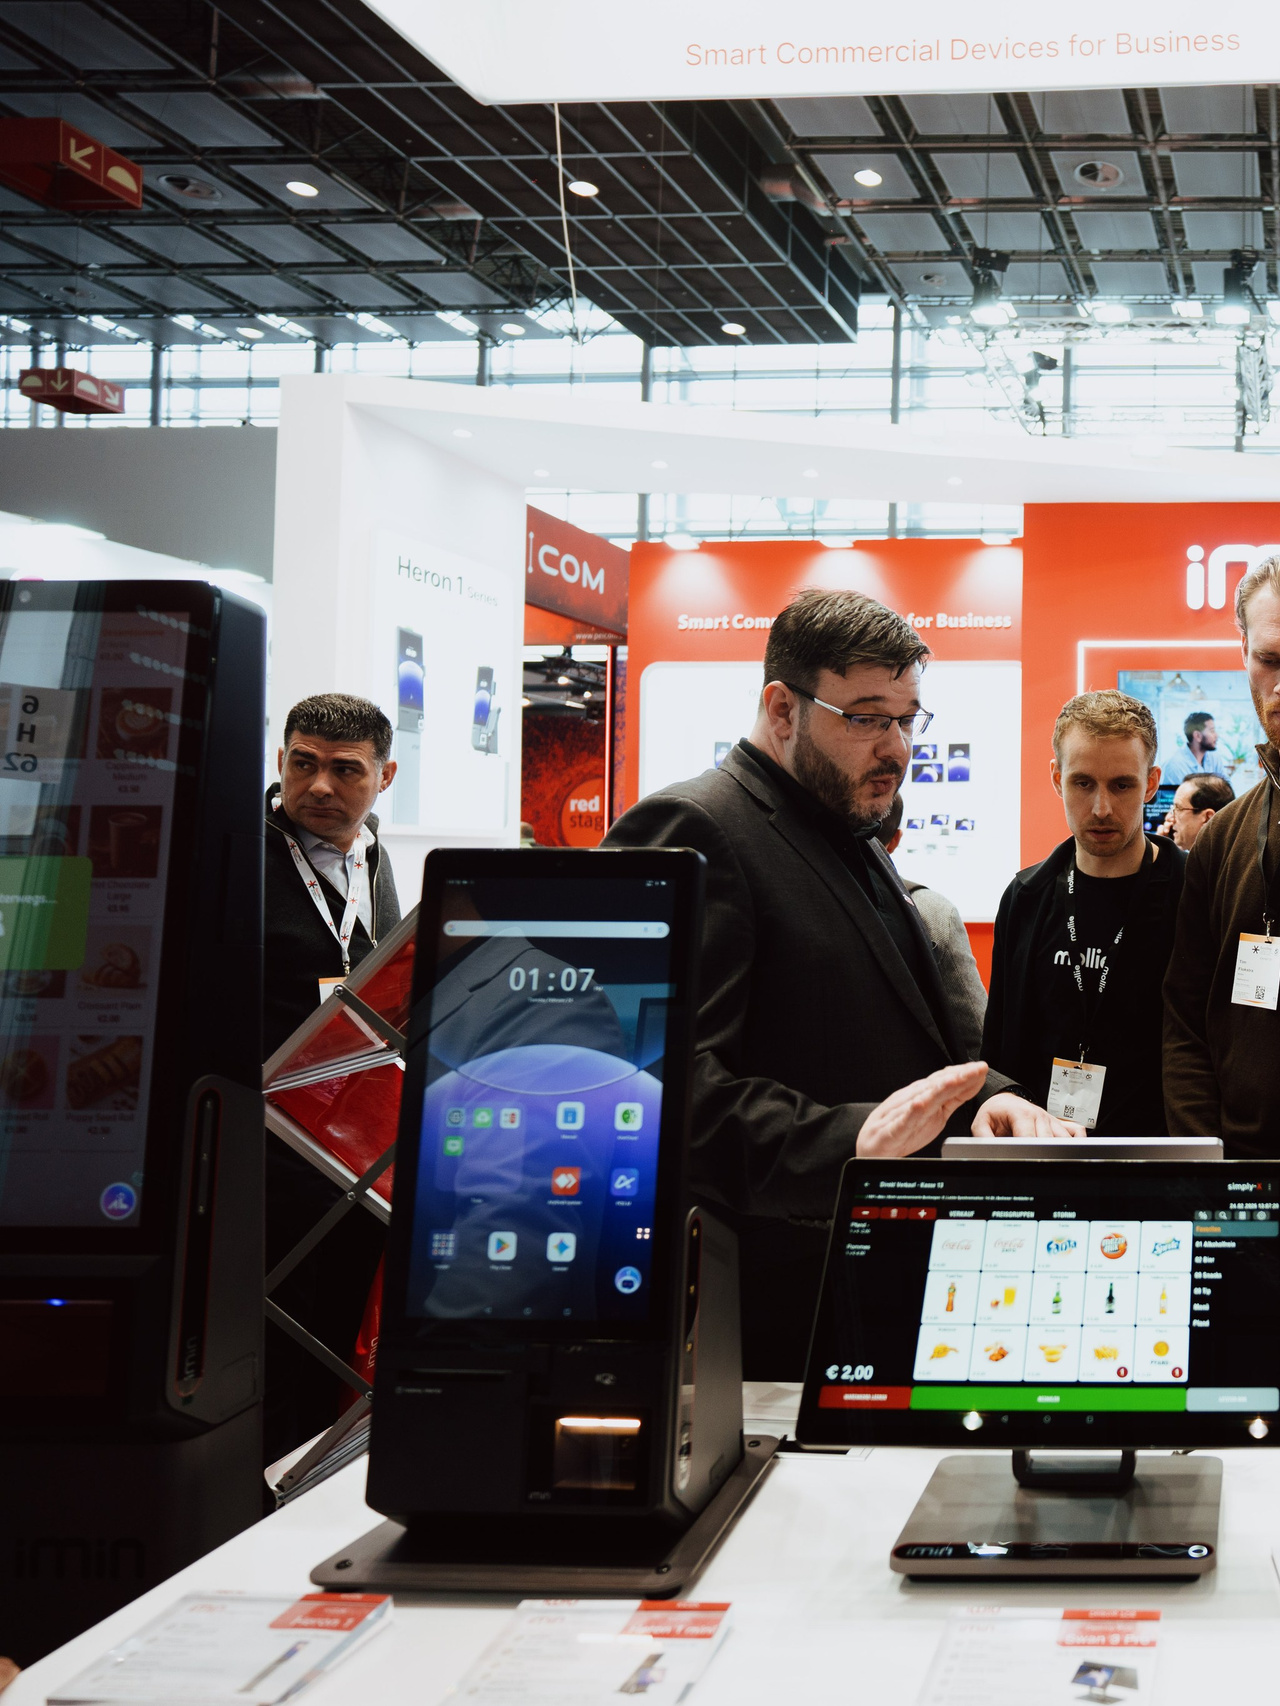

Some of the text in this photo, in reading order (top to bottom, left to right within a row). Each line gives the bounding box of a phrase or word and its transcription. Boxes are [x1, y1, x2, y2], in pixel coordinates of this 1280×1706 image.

[686, 30, 1240, 66] Smart Commercial Devices for Business
[398, 555, 499, 607] Heron 1 Series
[677, 614, 730, 631] Smart
[904, 612, 1012, 629] for Business
[569, 796, 601, 812] red
[1067, 870, 1075, 894] mollie
[1067, 915, 1077, 942] mollie
[367, 1335, 379, 1369] imin
[825, 1364, 874, 1382] € 2,00
[13, 1536, 146, 1580] imin
